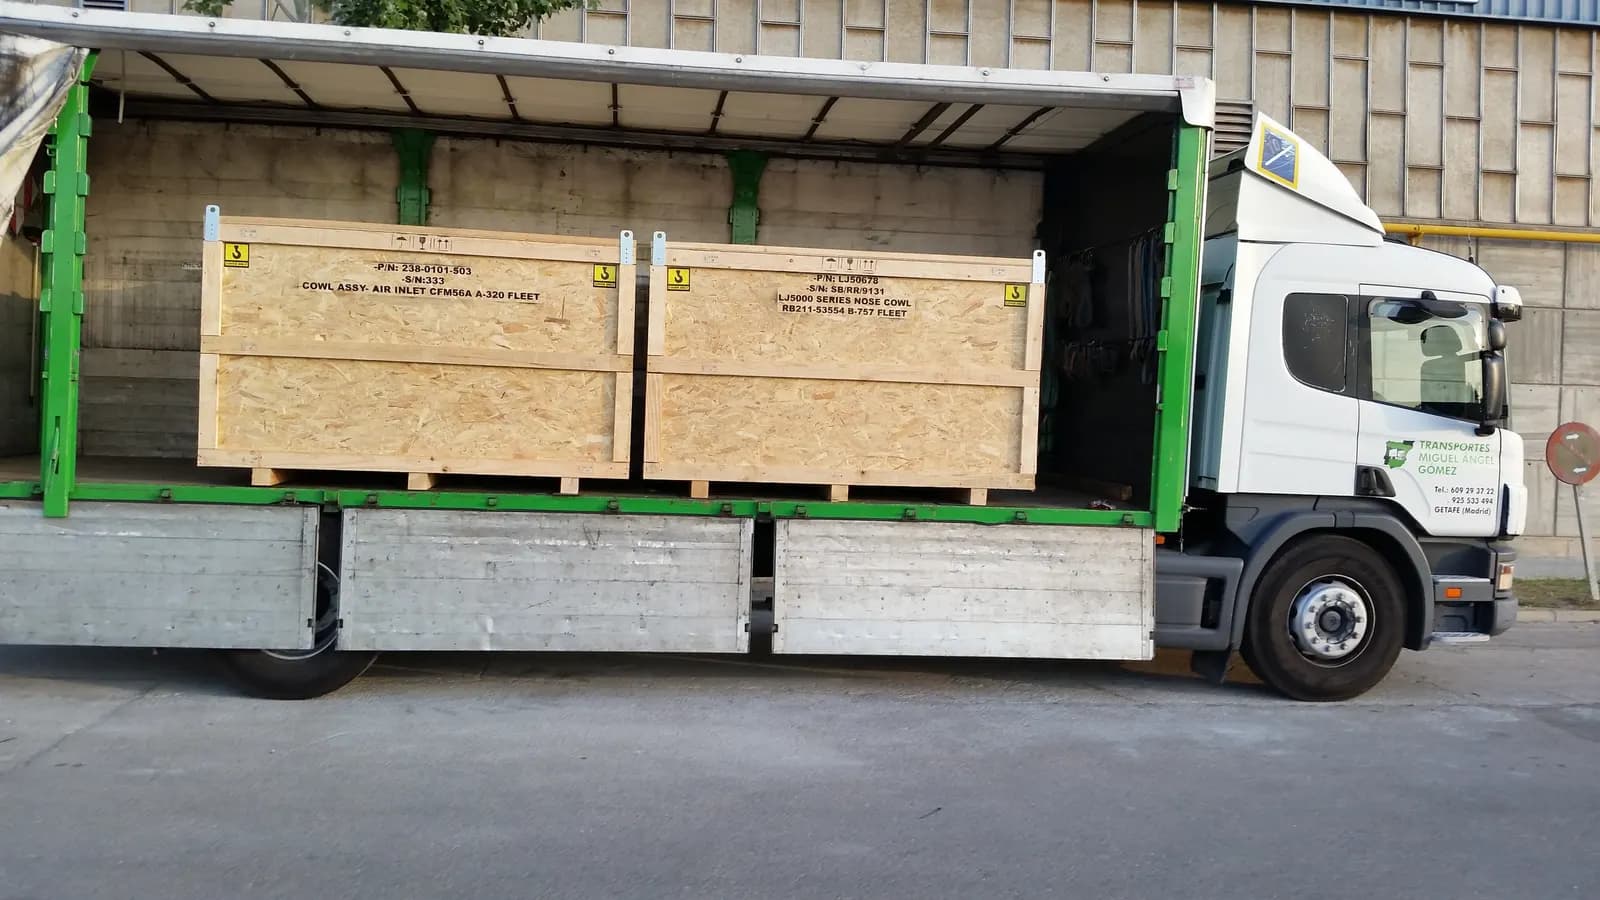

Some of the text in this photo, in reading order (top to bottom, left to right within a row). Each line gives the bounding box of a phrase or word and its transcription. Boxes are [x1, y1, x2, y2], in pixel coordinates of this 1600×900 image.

[373, 263, 472, 275] -P/N: 238-0101-503
[401, 275, 445, 285] -S/N:333
[813, 274, 879, 284] -P/N: LJ50678
[302, 281, 540, 301] COWL ASSY- AIR INLET CFM56A A-320 FLEET
[806, 284, 884, 295] -S/N: SB/RR/9131
[778, 294, 912, 307] LJ5000 SERIES NOSE COWL
[782, 304, 907, 317] RB211-53554 B-757 FLEET
[1419, 440, 1490, 453] TRANSPORTES
[1418, 453, 1458, 463] MIGUEL
[1434, 486, 1448, 494] Tel.:
[1451, 496, 1464, 504] 925
[1434, 506, 1491, 516] GETAFE (Madrid)
